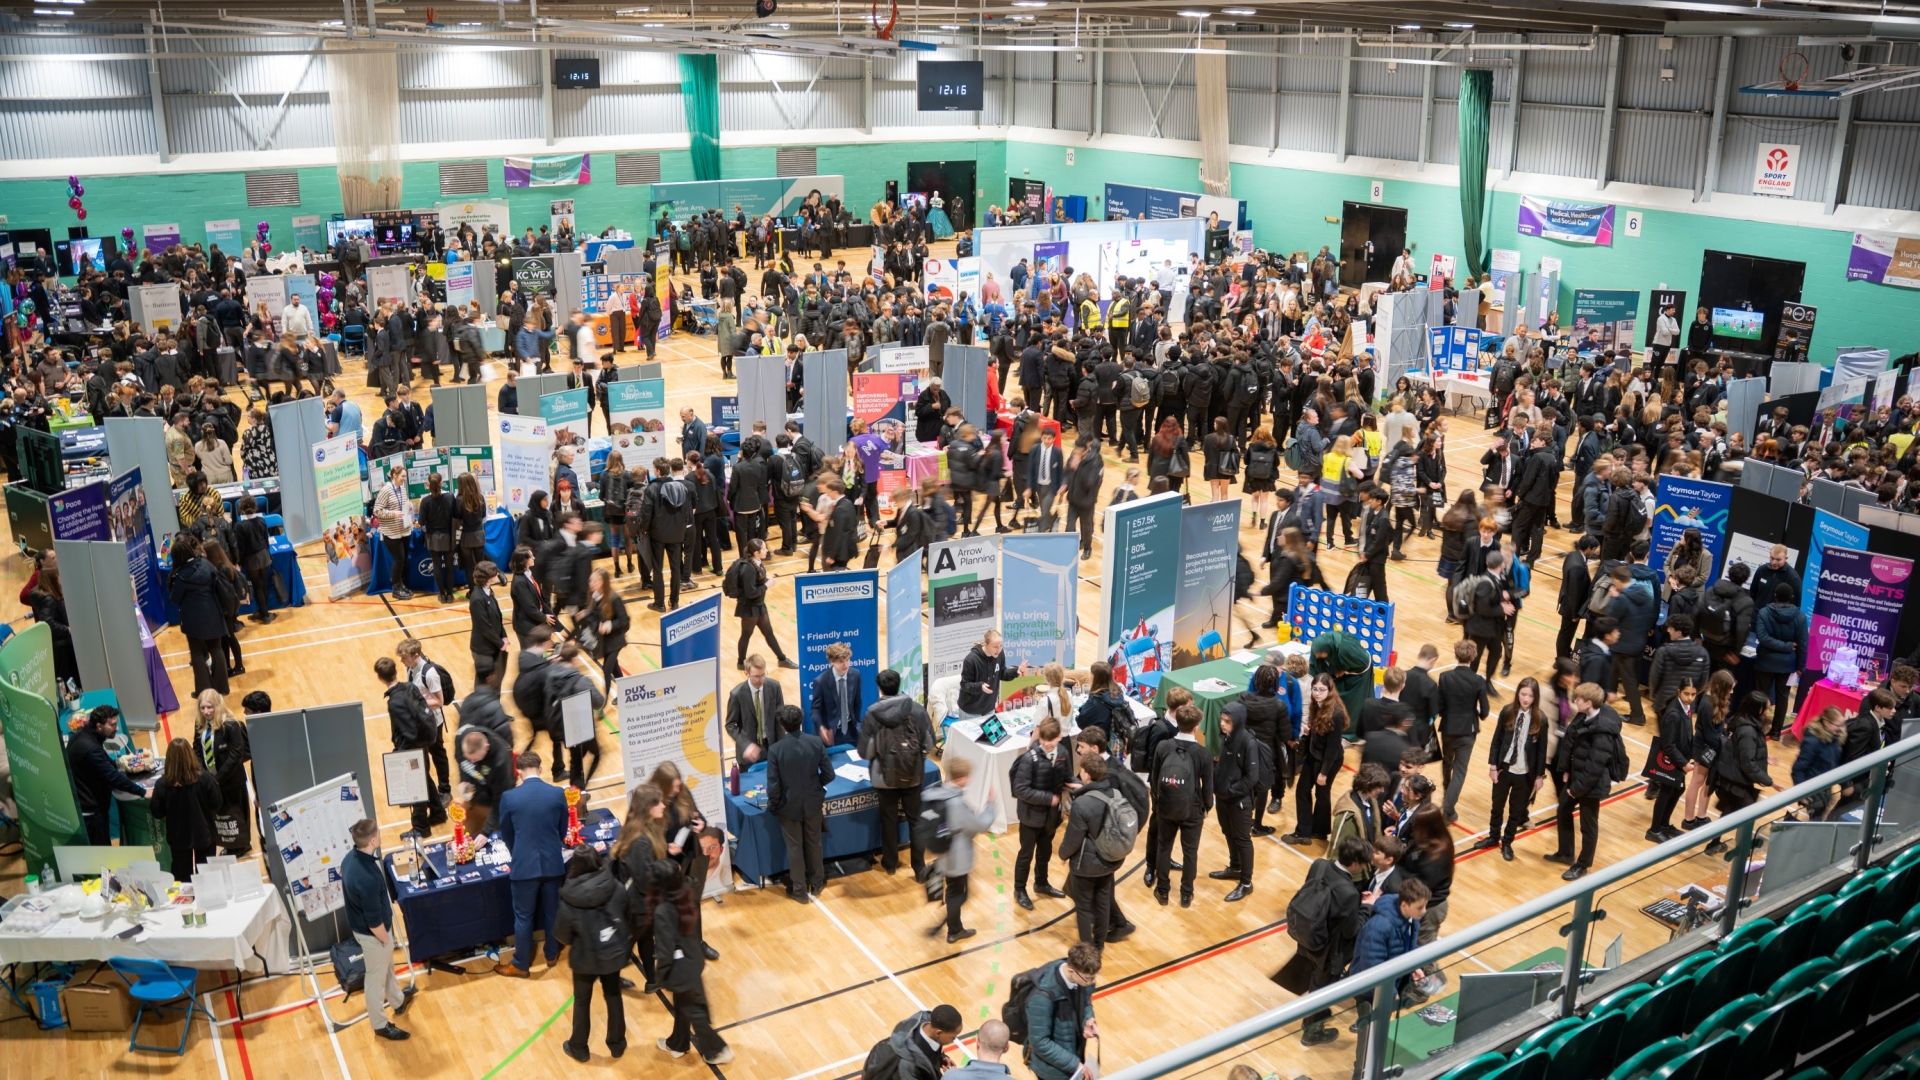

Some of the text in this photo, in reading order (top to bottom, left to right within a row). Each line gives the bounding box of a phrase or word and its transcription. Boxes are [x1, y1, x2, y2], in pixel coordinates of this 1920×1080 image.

[1374, 186, 1380, 197] 8
[1108, 205, 1130, 215] Leadership
[1550, 209, 1600, 220] Medical, Healthcare
[1630, 218, 1637, 230] 6
[516, 270, 552, 280] KC WEX
[65, 500, 81, 509] Pace
[57, 511, 82, 524] Changing
[92, 504, 104, 512] lives
[66, 517, 86, 529] children
[1132, 515, 1156, 528] £57.5K
[60, 520, 102, 538] neurodisabilities
[958, 547, 982, 557] Arrow
[1131, 543, 1145, 554] 80%
[960, 554, 995, 566] Planning
[1186, 551, 1208, 560] Because
[1130, 563, 1145, 574] 25M
[1185, 562, 1226, 576] society benefits
[1186, 558, 1206, 569] projects
[806, 584, 870, 600] RICHARDSONS
[1023, 611, 1049, 620] bring
[1004, 620, 1055, 629] innovative
[1830, 614, 1878, 632] DIRECTING
[807, 630, 841, 640] Friendly
[1004, 629, 1065, 639] high-quality
[1819, 625, 1885, 646] GAMES DESIGN
[1823, 638, 1875, 658] ANIMATION
[625, 685, 646, 696] DUX
[625, 686, 676, 703] ADVISORY
[641, 711, 664, 721] training
[665, 705, 691, 716] practice,
[628, 720, 661, 731] committed
[670, 712, 692, 722] guiding
[628, 726, 666, 738] accountants
[690, 717, 704, 726] path
[643, 732, 672, 744] successful
